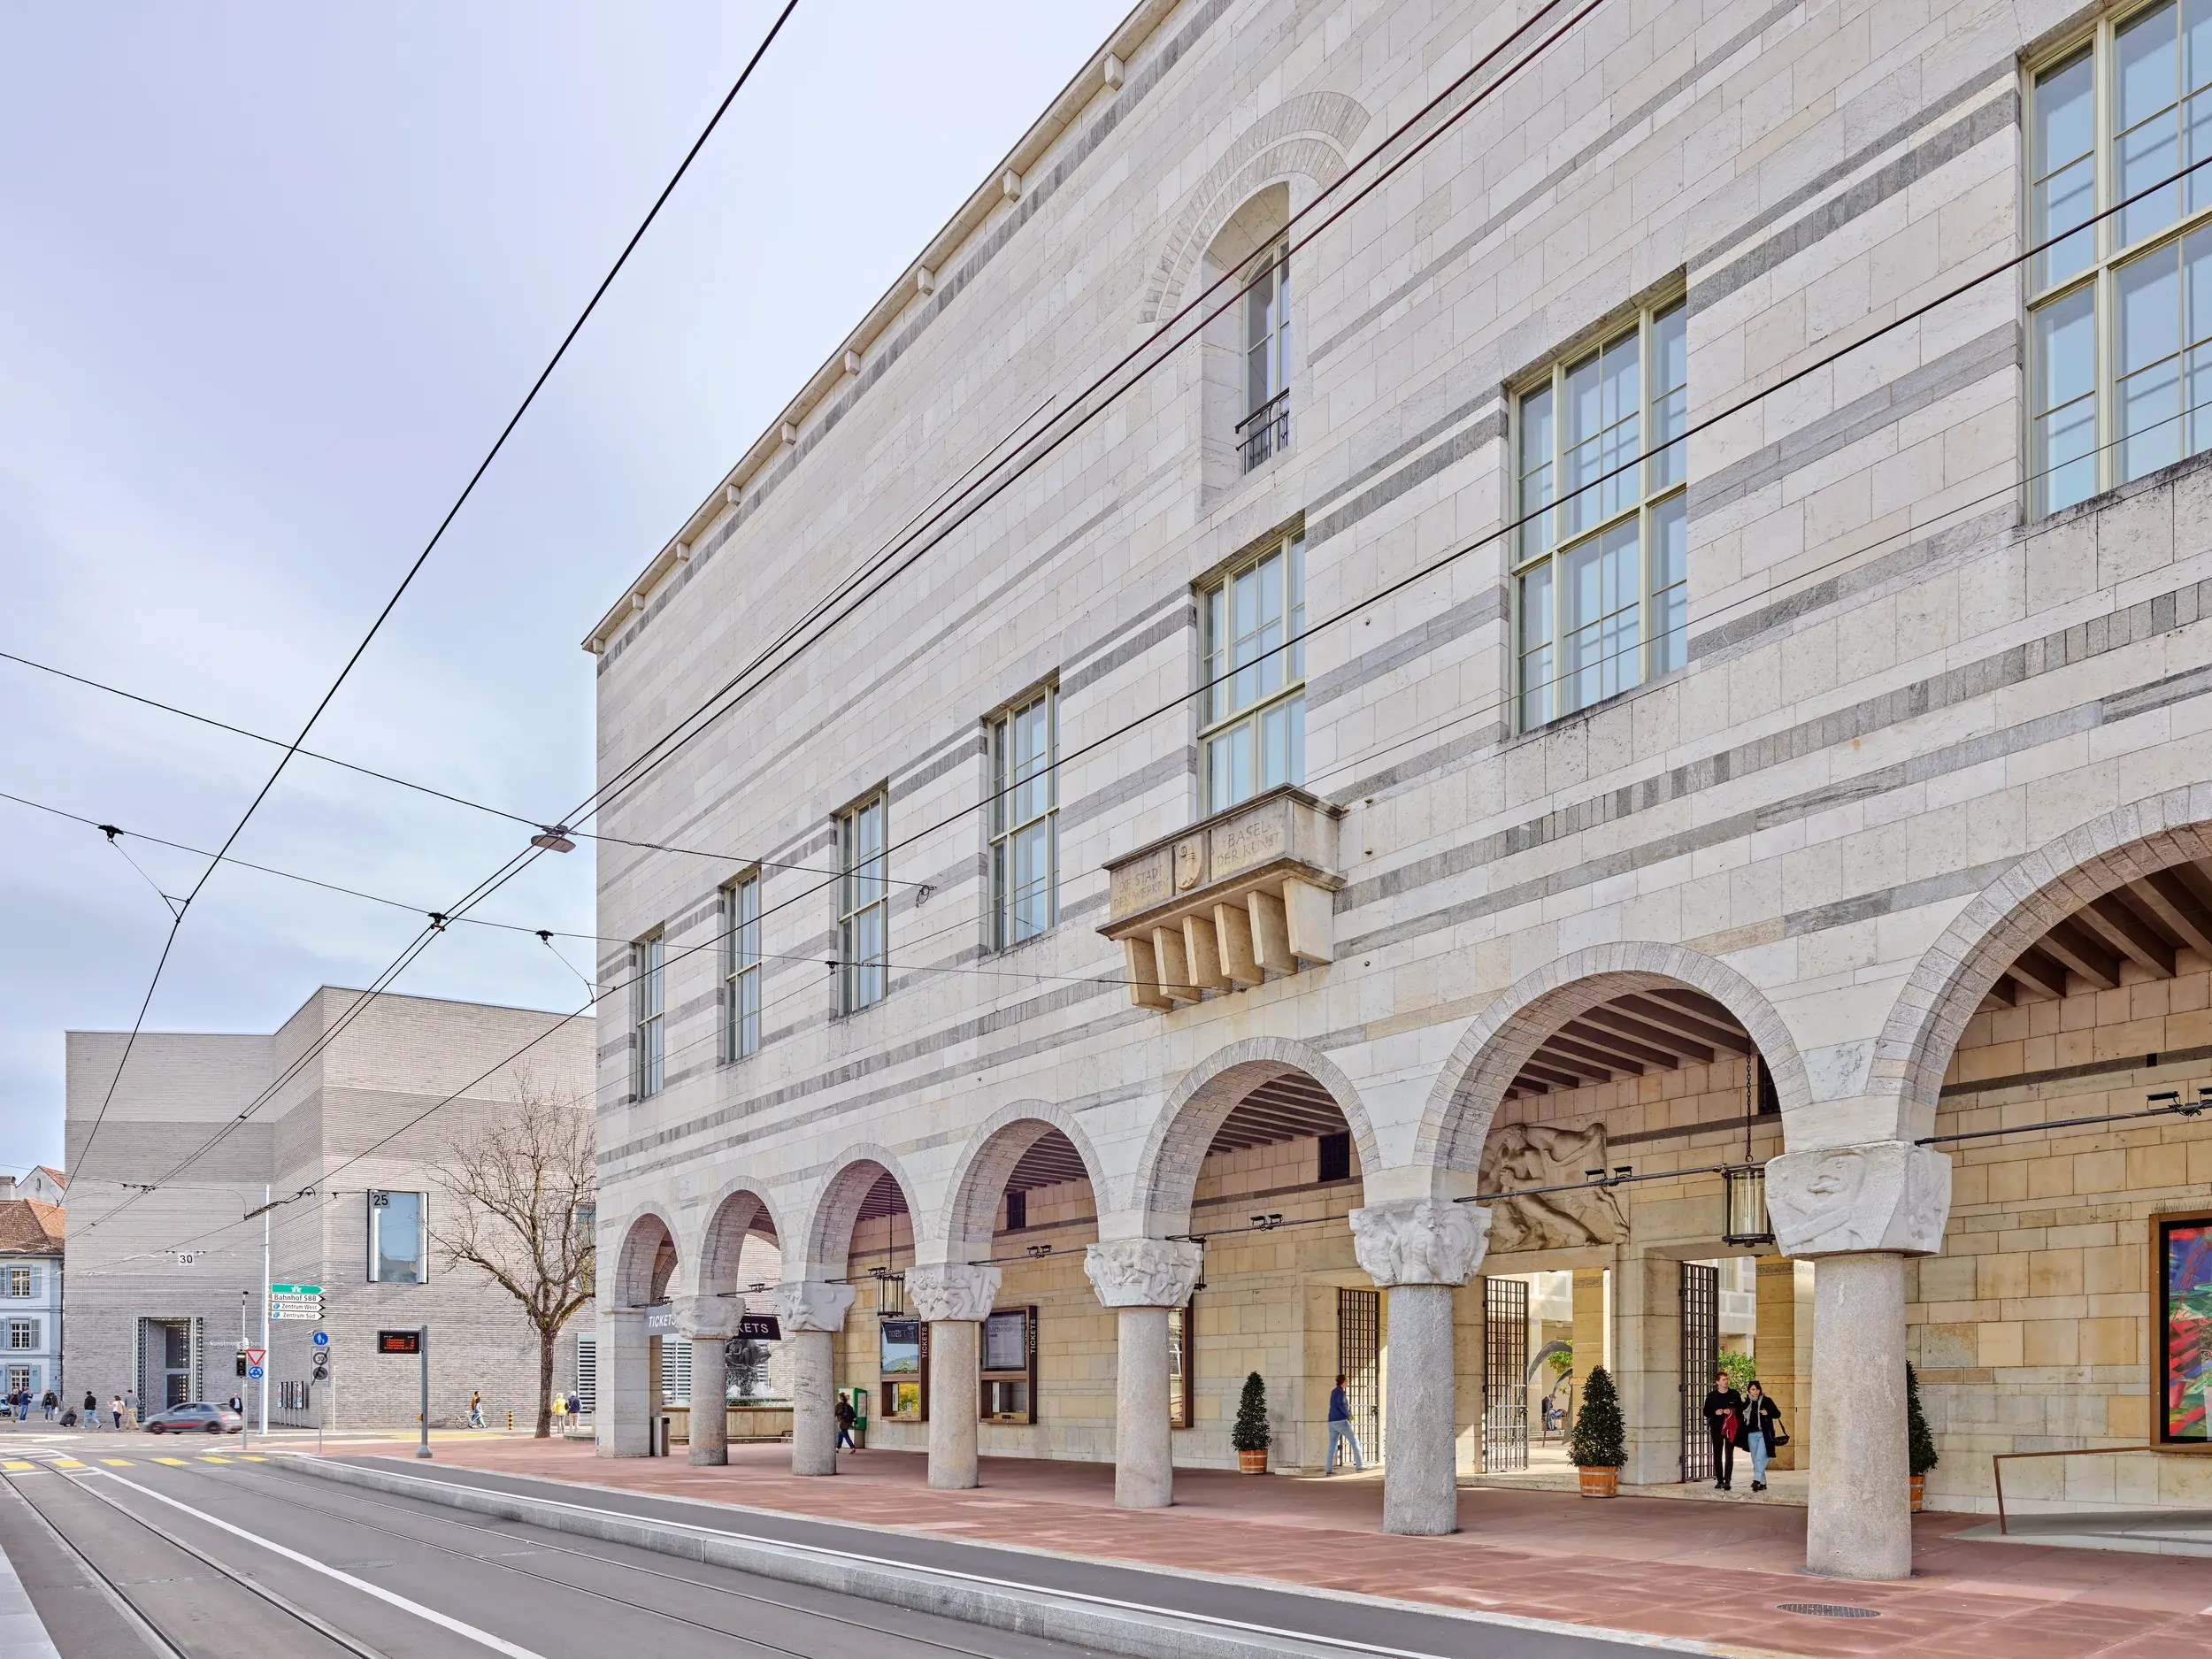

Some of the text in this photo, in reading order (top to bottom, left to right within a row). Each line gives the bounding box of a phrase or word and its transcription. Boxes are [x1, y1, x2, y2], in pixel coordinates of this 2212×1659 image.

[1118, 821, 1268, 893] DIE STADT BASEL
[1128, 880, 1168, 899] WERKEN
[1217, 849, 1239, 868] DER
[1242, 831, 1280, 857] KUNST
[373, 1194, 388, 1206] 25
[180, 1255, 193, 1263] 30
[649, 1314, 676, 1328] TICKETS
[739, 1323, 769, 1333] KETS
